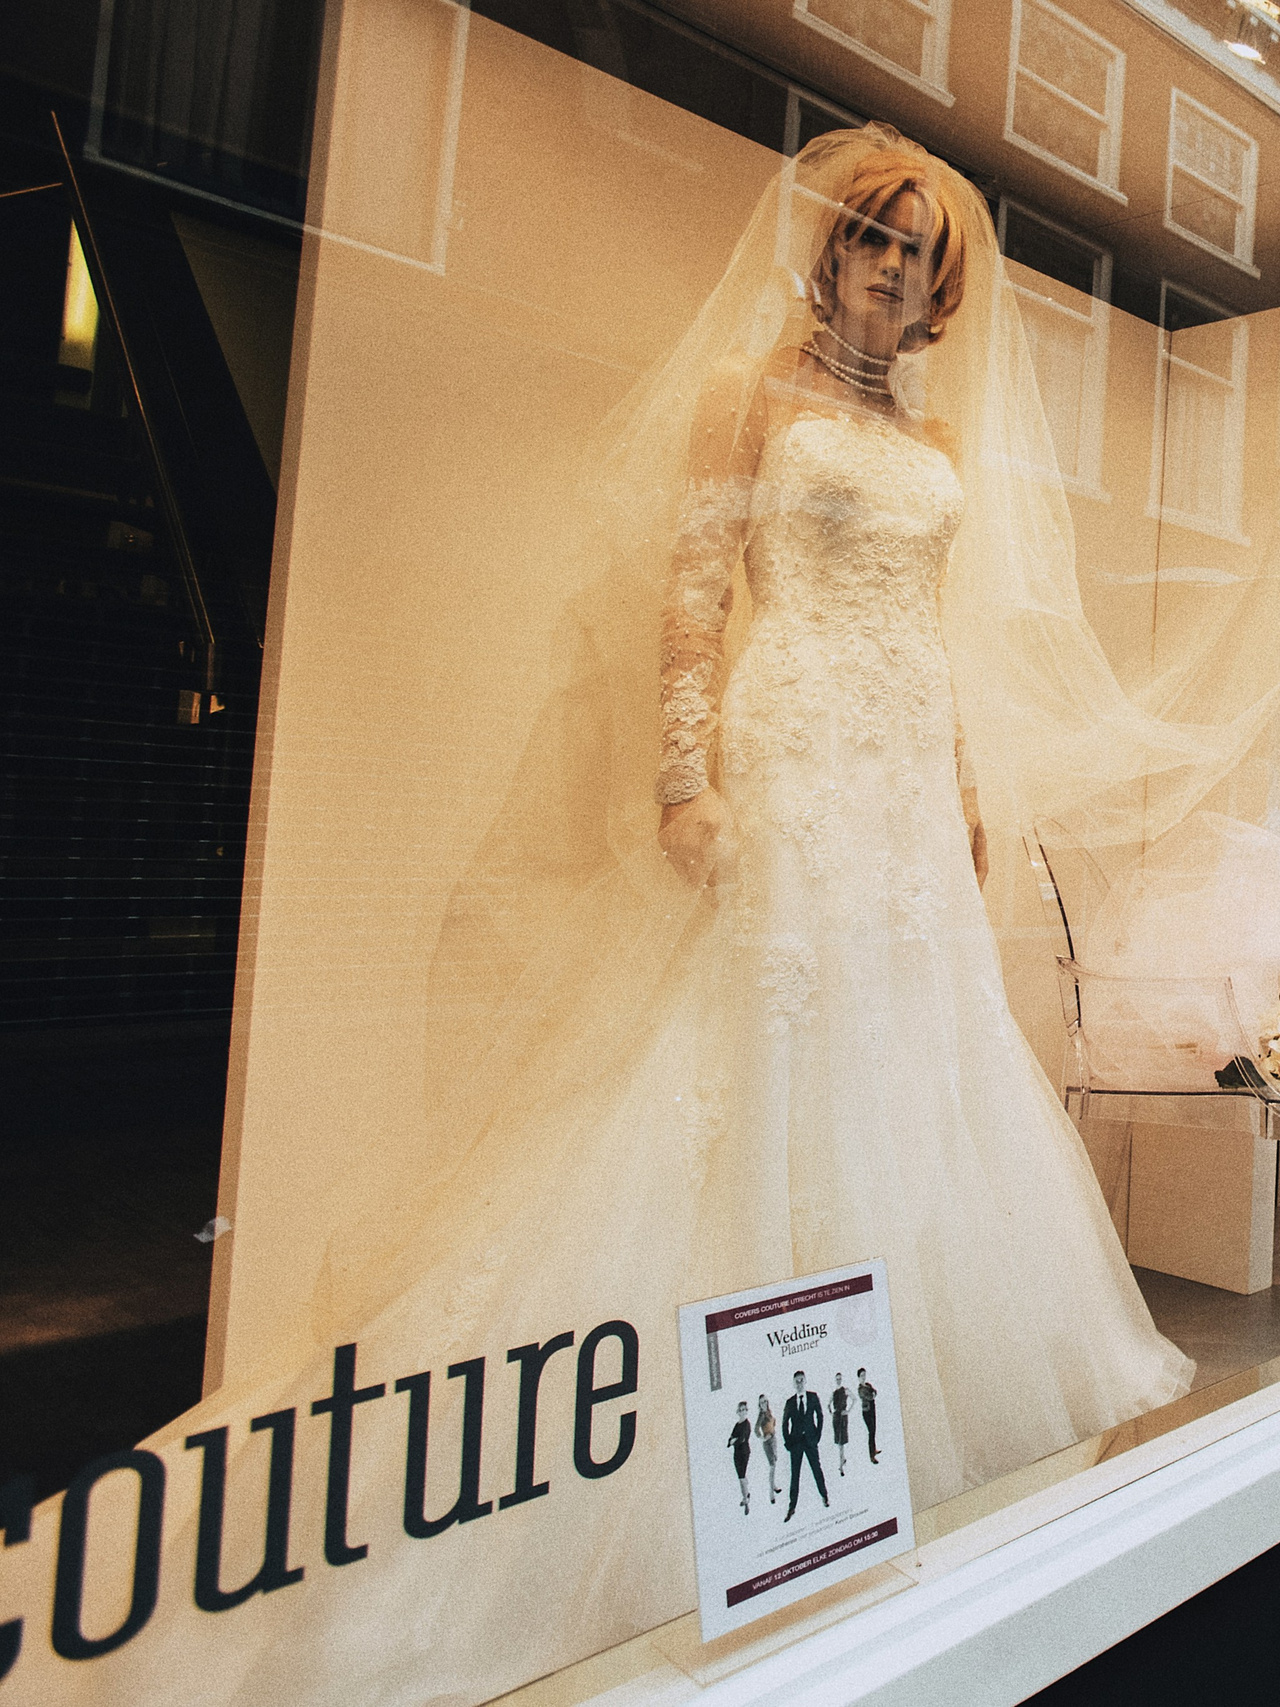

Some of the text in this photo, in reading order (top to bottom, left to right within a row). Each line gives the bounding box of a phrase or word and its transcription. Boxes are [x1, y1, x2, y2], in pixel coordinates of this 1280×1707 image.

[734, 1307, 760, 1320] COVERS
[760, 1300, 790, 1313] COUTURE
[790, 1293, 817, 1305] UTRECHT
[817, 1290, 823, 1298] IS
[824, 1289, 831, 1297] TE
[766, 1323, 828, 1347] Wedding
[781, 1339, 819, 1357] Planner
[752, 1577, 772, 1590] VANAF
[774, 1572, 782, 1580] 12
[782, 1560, 812, 1577] OKTOBER
[812, 1553, 827, 1564] ELKE
[828, 1542, 853, 1557] ZONDAG
[853, 1537, 863, 1546] OM
